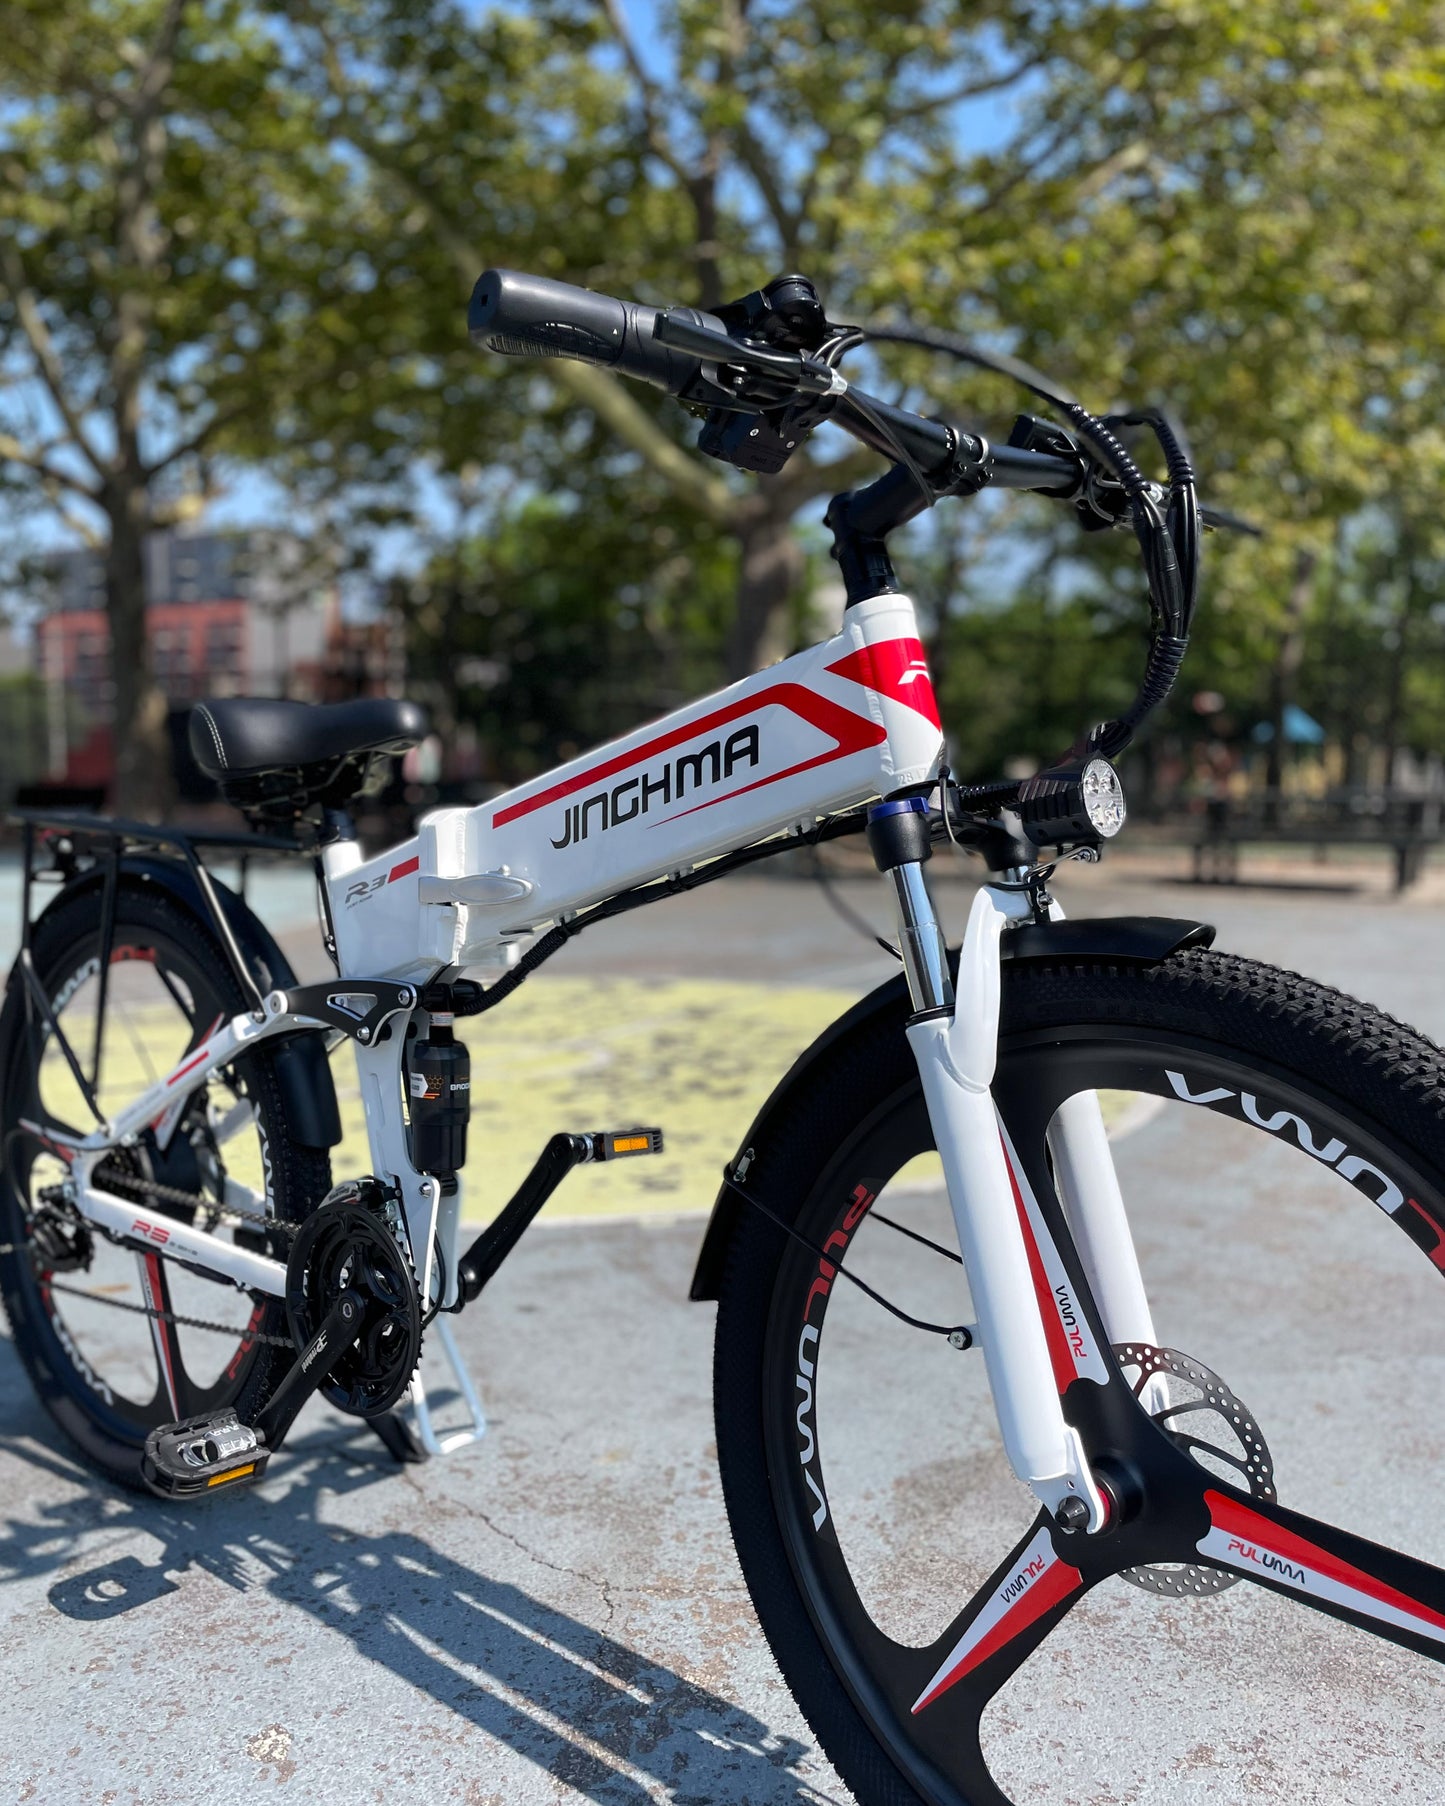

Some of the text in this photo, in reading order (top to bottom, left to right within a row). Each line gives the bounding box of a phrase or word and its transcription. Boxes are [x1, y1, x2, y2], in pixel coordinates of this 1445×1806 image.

[550, 724, 759, 849] JINGHMA
[345, 874, 387, 904] R3
[1055, 1284, 1088, 1358] PULUMA
[797, 1183, 875, 1532] PULUMA
[1000, 1553, 1046, 1604] PULUMA
[1228, 1538, 1305, 1585] PULUMA
